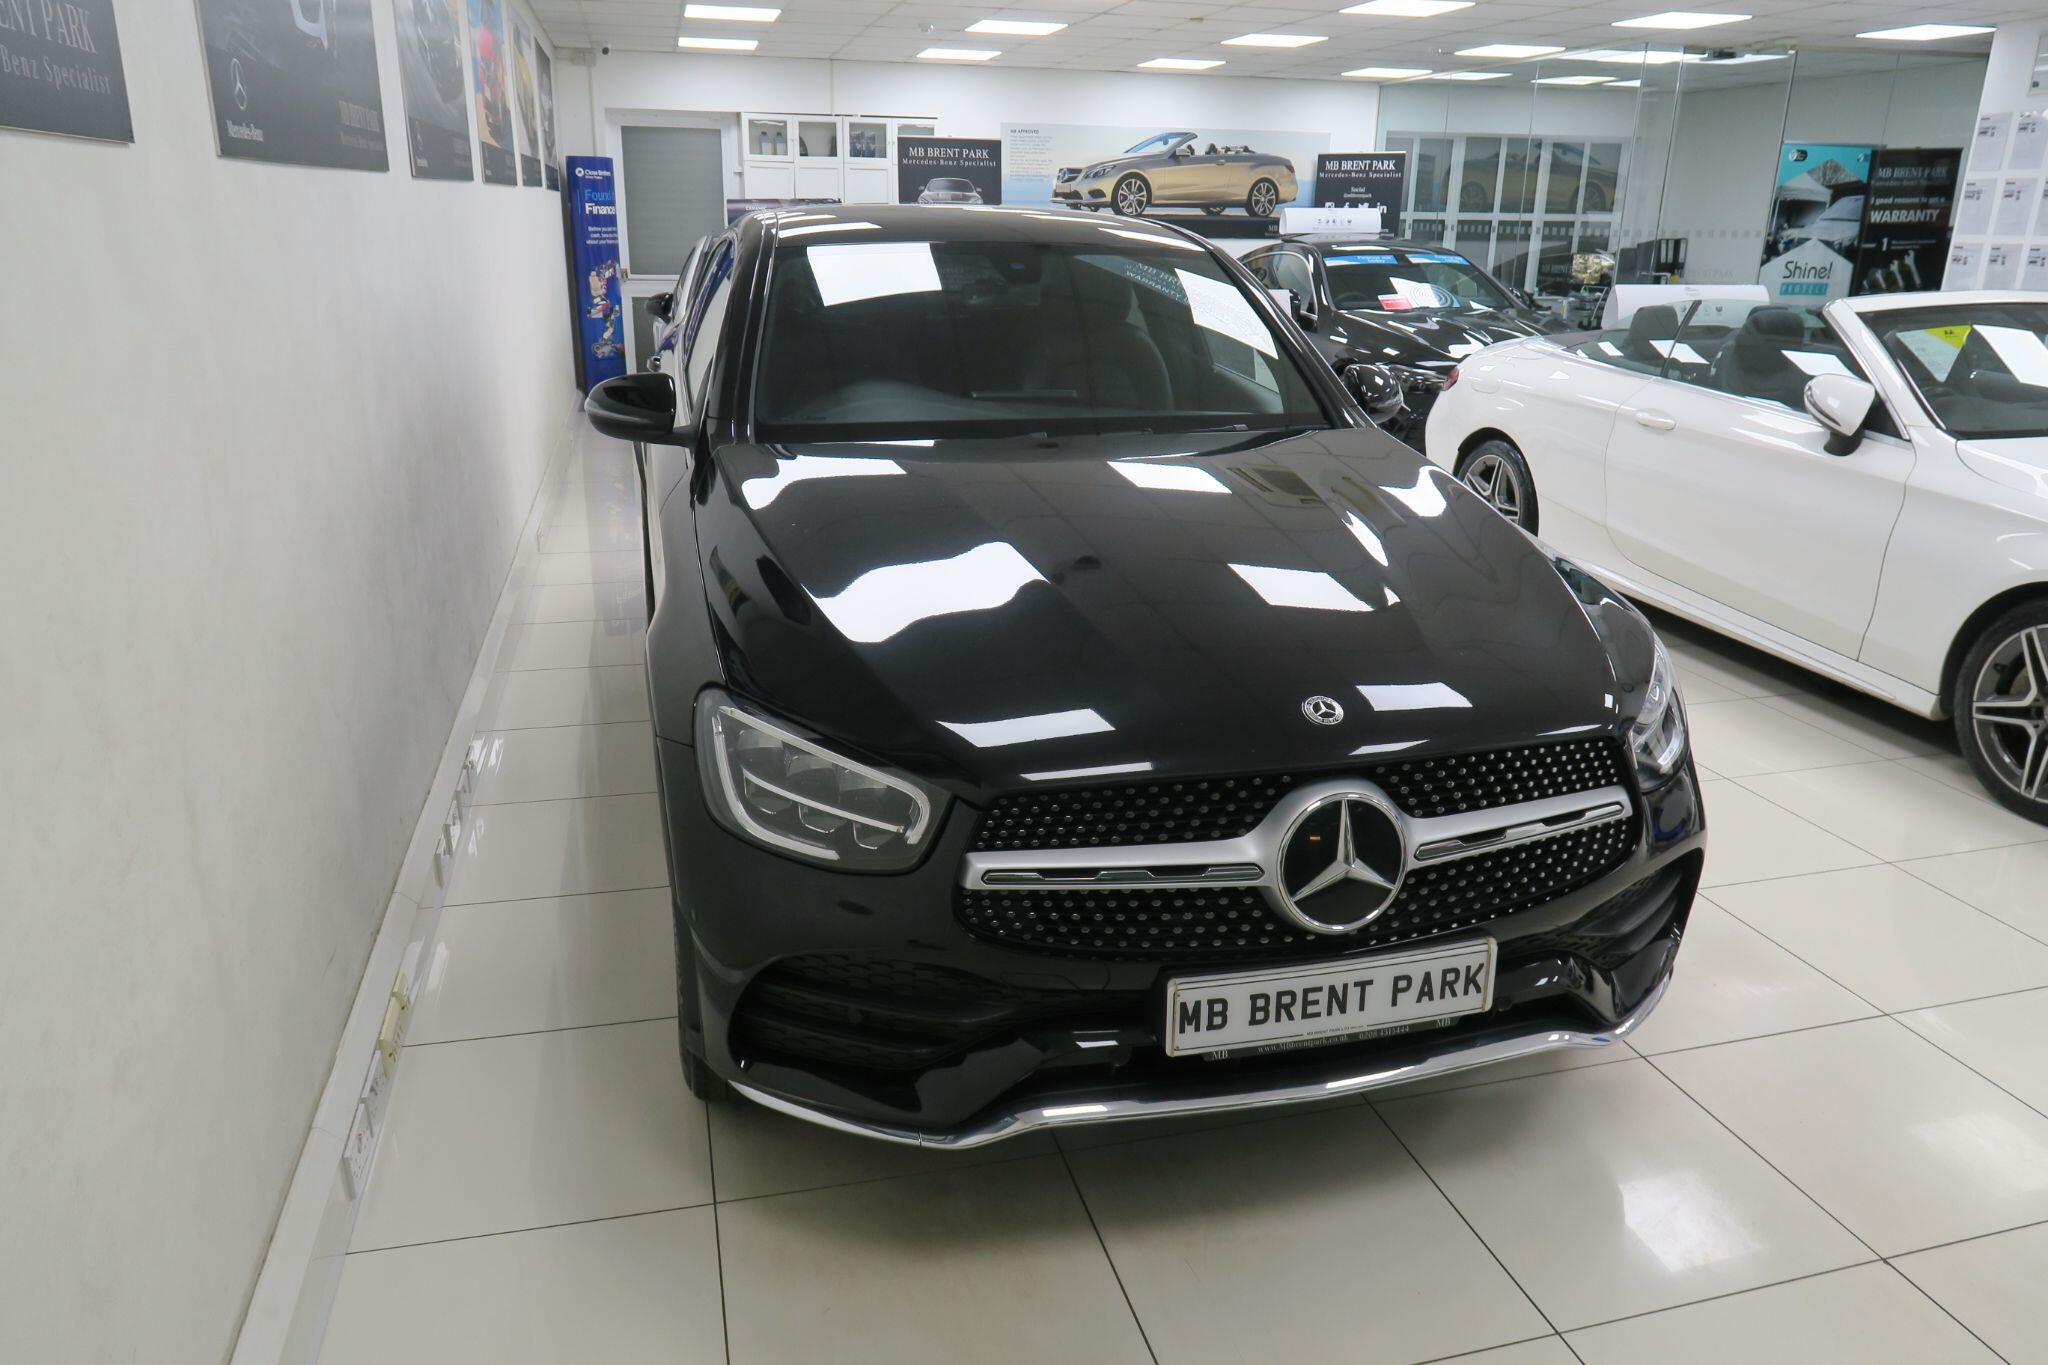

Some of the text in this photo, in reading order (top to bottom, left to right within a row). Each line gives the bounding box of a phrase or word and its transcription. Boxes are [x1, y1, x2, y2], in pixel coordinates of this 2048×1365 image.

[43, 56, 112, 94] Specialist
[909, 147, 989, 159] MB BRENT PARK
[960, 160, 996, 168] Specialist
[1325, 160, 1396, 171] MB BRENT PARK
[1871, 209, 1940, 223] WARRANTY
[1783, 261, 1833, 279] Shine!
[1178, 962, 1485, 1034] MB BRENT PARK
[1436, 1017, 1452, 1028] MB
[1212, 1048, 1230, 1060] MB
